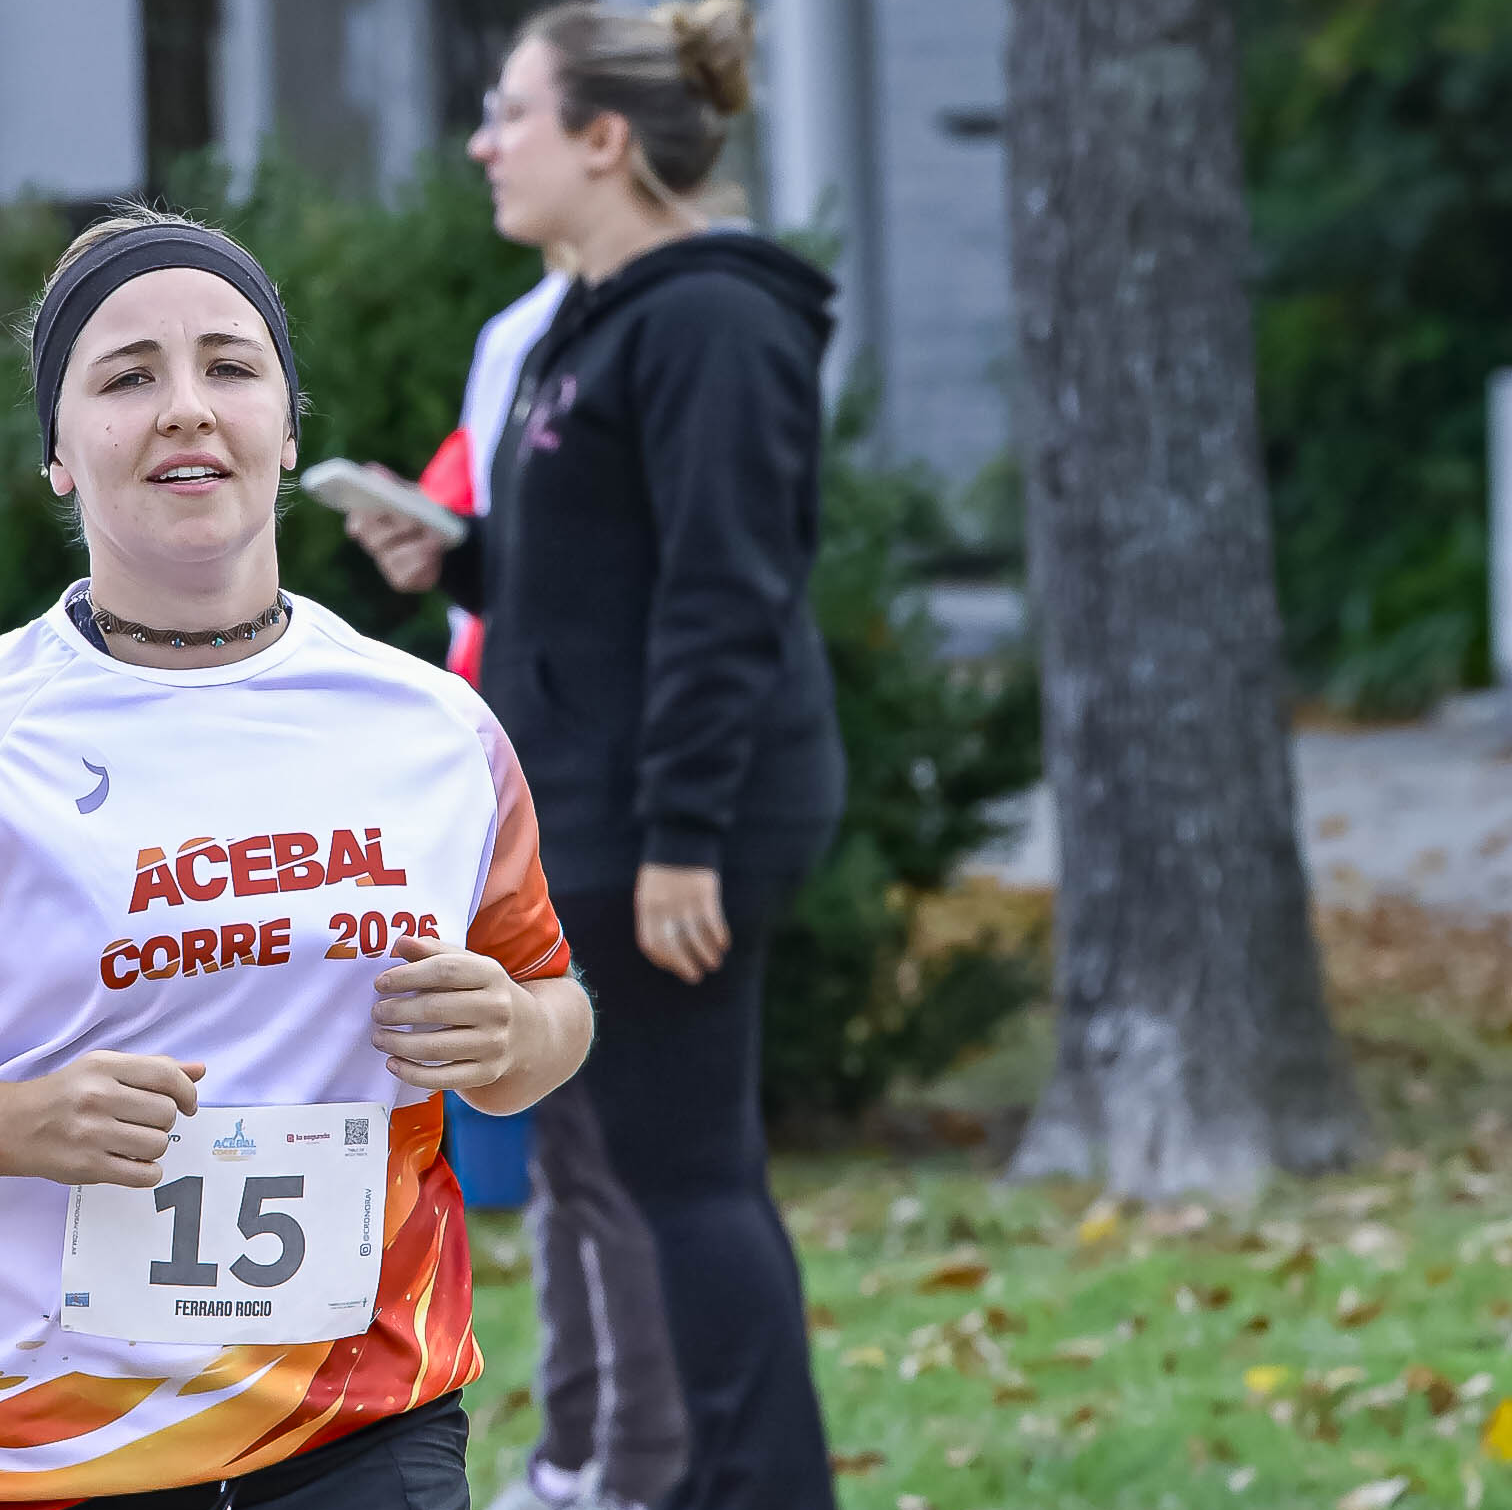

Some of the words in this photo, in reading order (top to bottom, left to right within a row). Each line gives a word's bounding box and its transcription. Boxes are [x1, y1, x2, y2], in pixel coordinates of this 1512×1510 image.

[128, 827, 407, 914] ACEBAL
[99, 918, 291, 991] CORRE
[149, 1175, 305, 1288] 15
[175, 1299, 232, 1317] FERRARO
[235, 1300, 272, 1317] ROCIO
